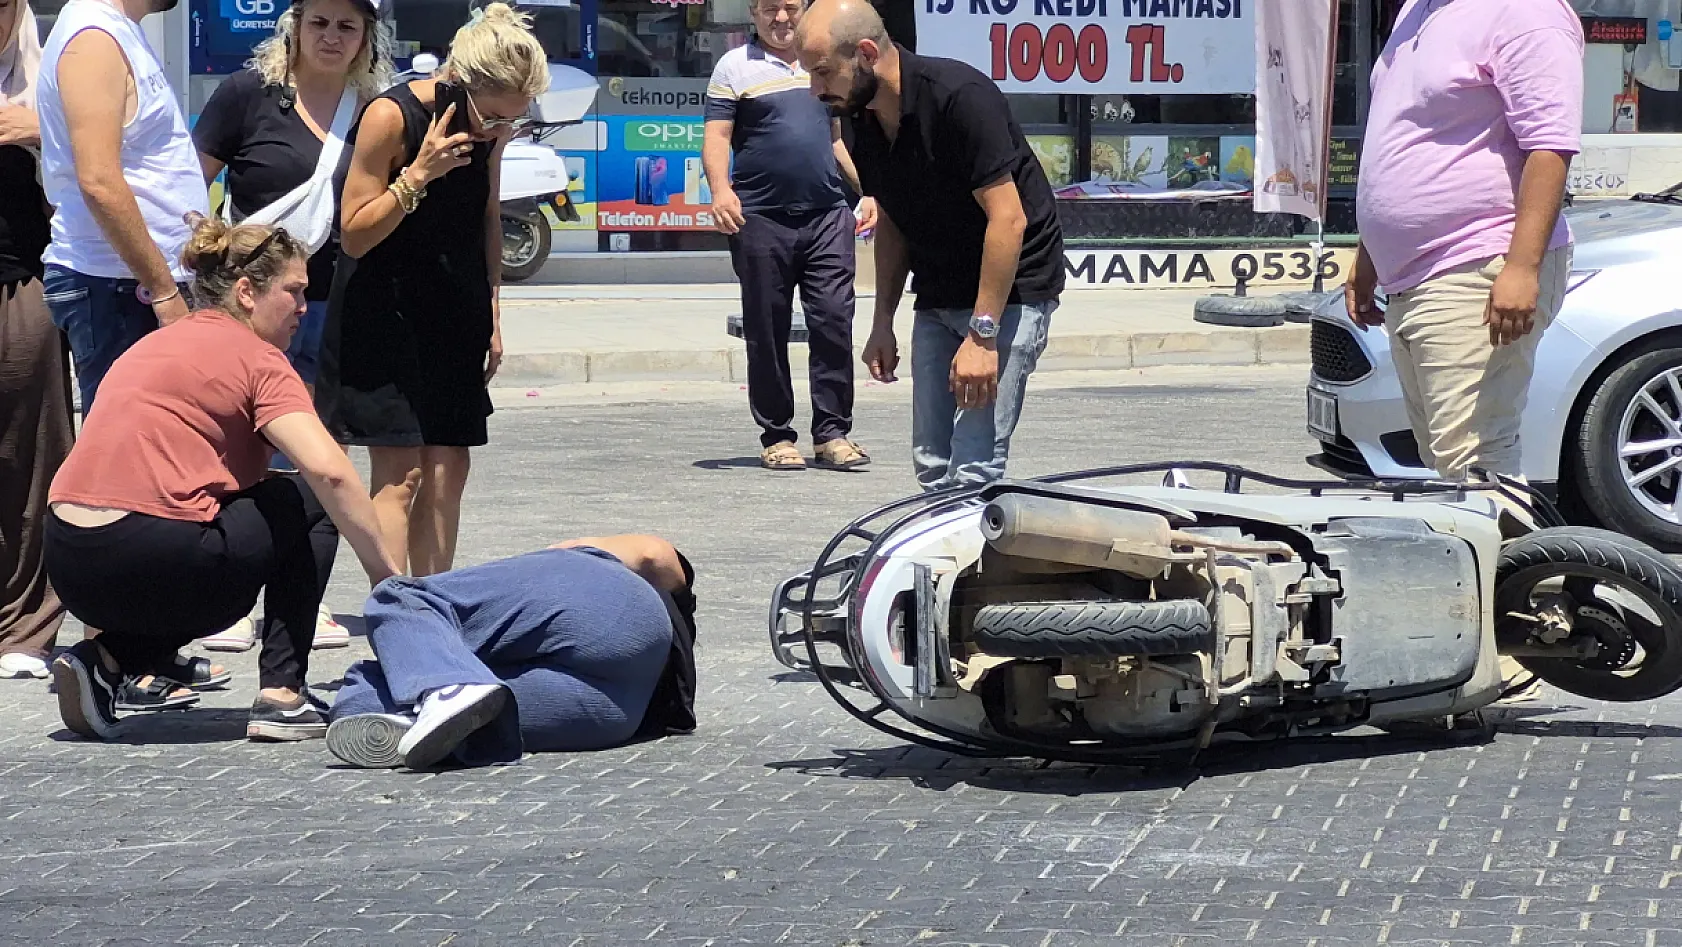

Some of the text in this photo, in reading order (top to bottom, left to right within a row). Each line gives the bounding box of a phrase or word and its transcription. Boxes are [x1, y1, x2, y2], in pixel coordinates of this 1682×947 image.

[989, 22, 1108, 83] 1000
[598, 211, 654, 226] Telefon
[1063, 250, 1341, 284] MAMA 0536
